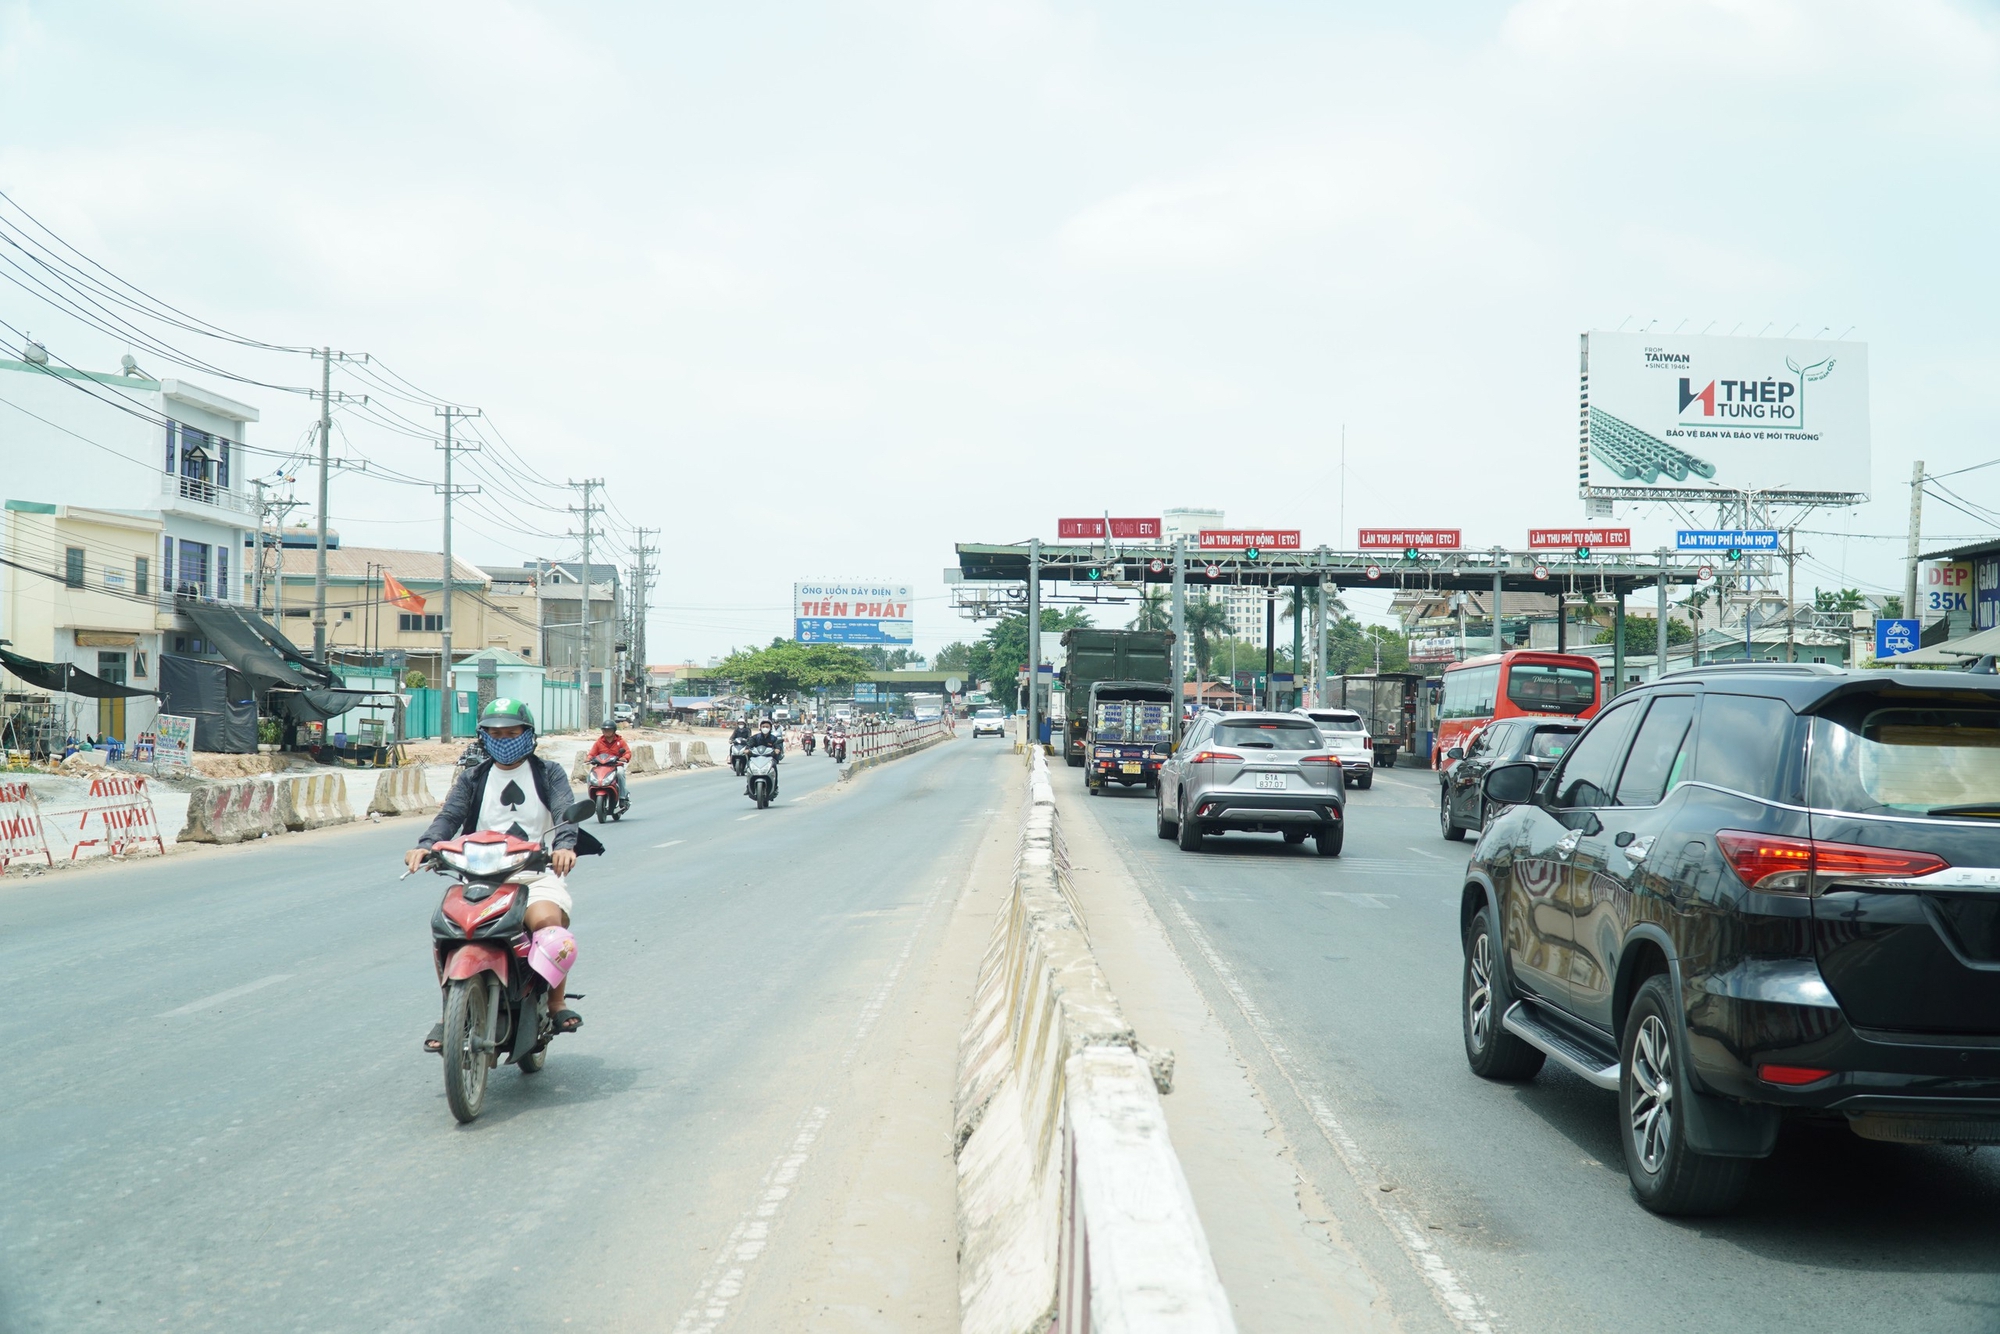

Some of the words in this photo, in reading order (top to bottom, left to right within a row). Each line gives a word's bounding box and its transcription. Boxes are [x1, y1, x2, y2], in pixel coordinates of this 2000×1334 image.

[1645, 353, 1690, 363] TAIWAN
[1721, 377, 1795, 403] THÉP
[1717, 403, 1766, 418] TUNG
[1770, 405, 1795, 419] HO
[1700, 430, 1718, 439] BẠN
[1720, 430, 1731, 438] VÀ
[1201, 533, 1215, 545] LÀN
[1216, 535, 1230, 545] THU
[1232, 533, 1244, 545] PHÍ
[1245, 535, 1255, 547] TỰ
[1256, 533, 1275, 547] ĐỘNG
[1362, 532, 1376, 544] LÀN
[1377, 534, 1390, 543] THU
[1392, 532, 1404, 544] PHÍ
[1405, 533, 1415, 546] TỰ
[1415, 532, 1434, 546] ĐỘNG
[1532, 532, 1546, 543] LÀN
[1547, 533, 1560, 543] THU
[1562, 531, 1573, 543] PHÍ
[1574, 533, 1584, 546] TỰ
[1585, 531, 1603, 546] ĐỘNG
[1680, 533, 1697, 545] LÀN
[1699, 535, 1717, 545] THU
[1719, 533, 1733, 545] PHÍ
[1735, 531, 1754, 545] HỖN
[1755, 535, 1774, 548] HỢP
[1929, 563, 1968, 586] DÉP
[851, 586, 869, 596] DÂY
[871, 586, 891, 597] ĐIỆN
[801, 596, 848, 616] TIẾN
[855, 599, 907, 617] PHÁT
[1929, 592, 1968, 610] 35K
